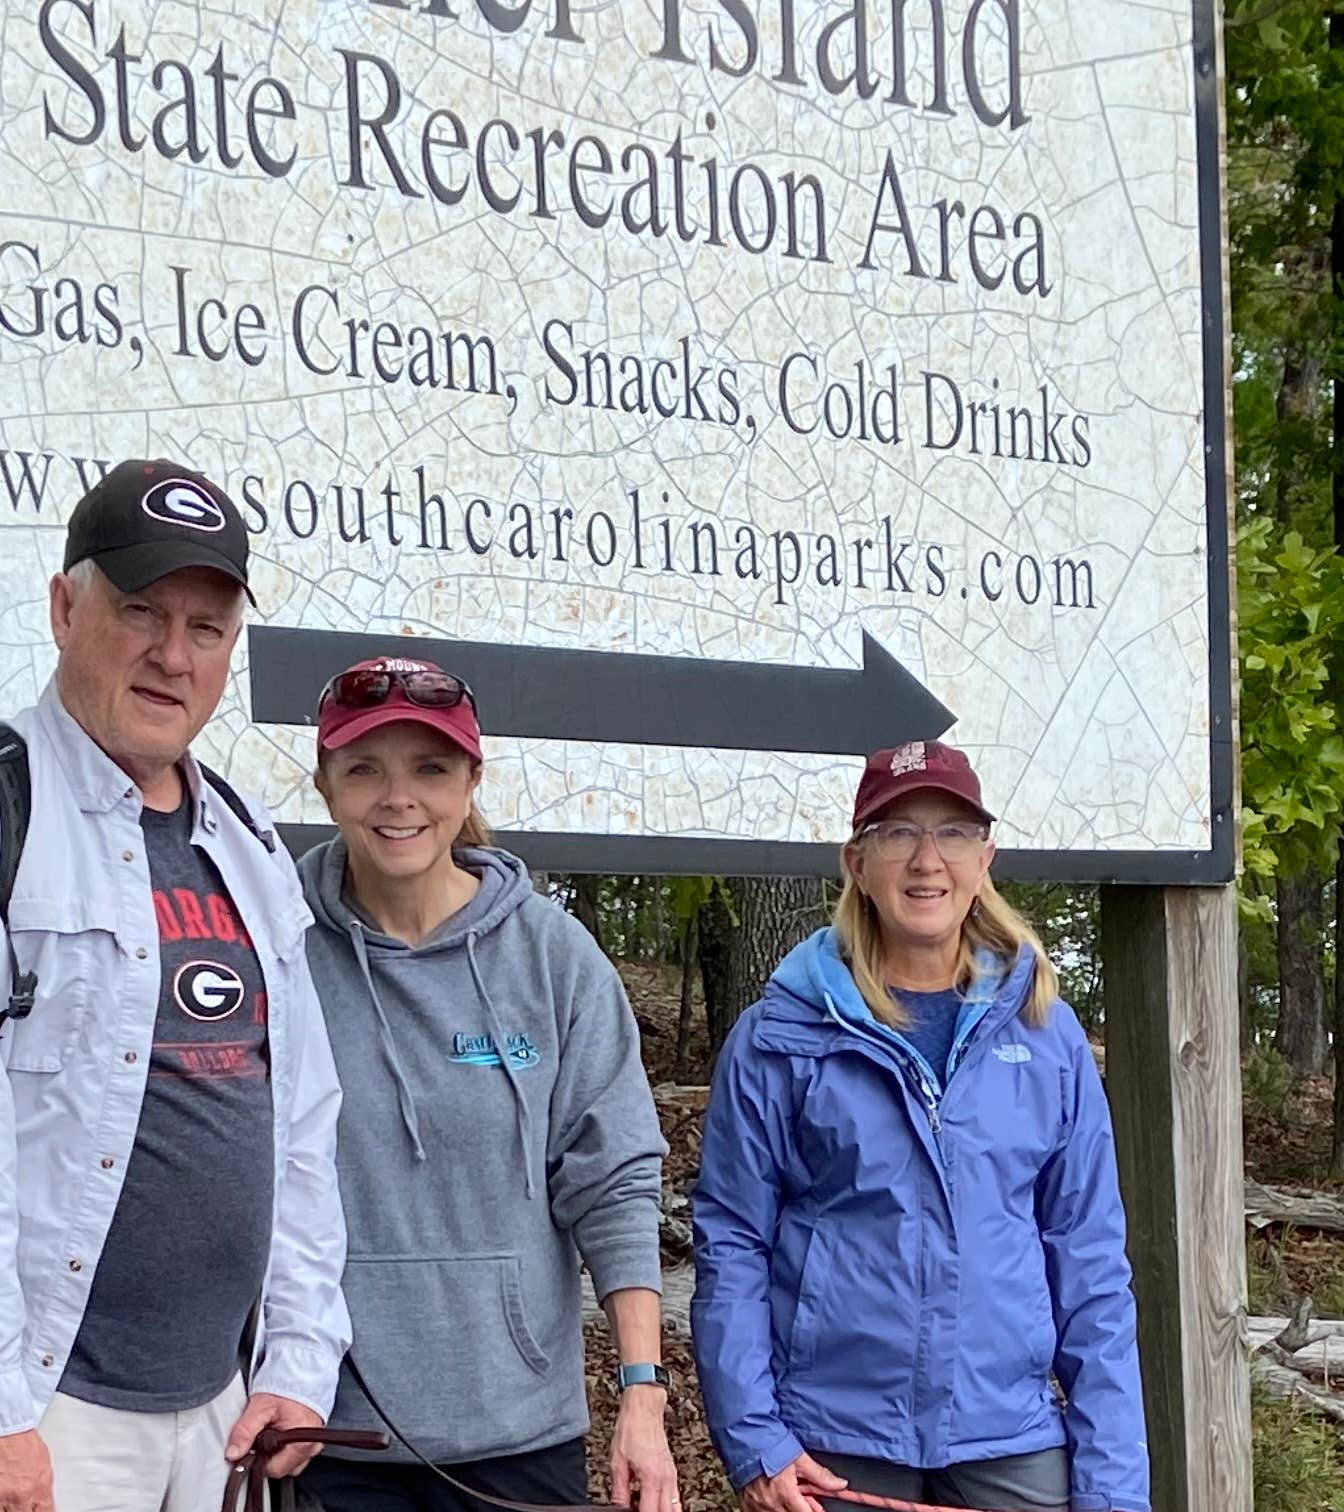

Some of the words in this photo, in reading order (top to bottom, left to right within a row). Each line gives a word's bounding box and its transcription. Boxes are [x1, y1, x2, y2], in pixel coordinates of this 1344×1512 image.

[38, 0, 299, 178] State
[333, 47, 835, 265] Recreation
[859, 148, 1054, 299] Area
[168, 265, 269, 367] Ice
[292, 284, 519, 417] Cream,
[542, 318, 757, 446] Snacks,
[777, 352, 904, 446] Cold
[920, 369, 1093, 469] Drinks
[173, 959, 245, 1022] G
